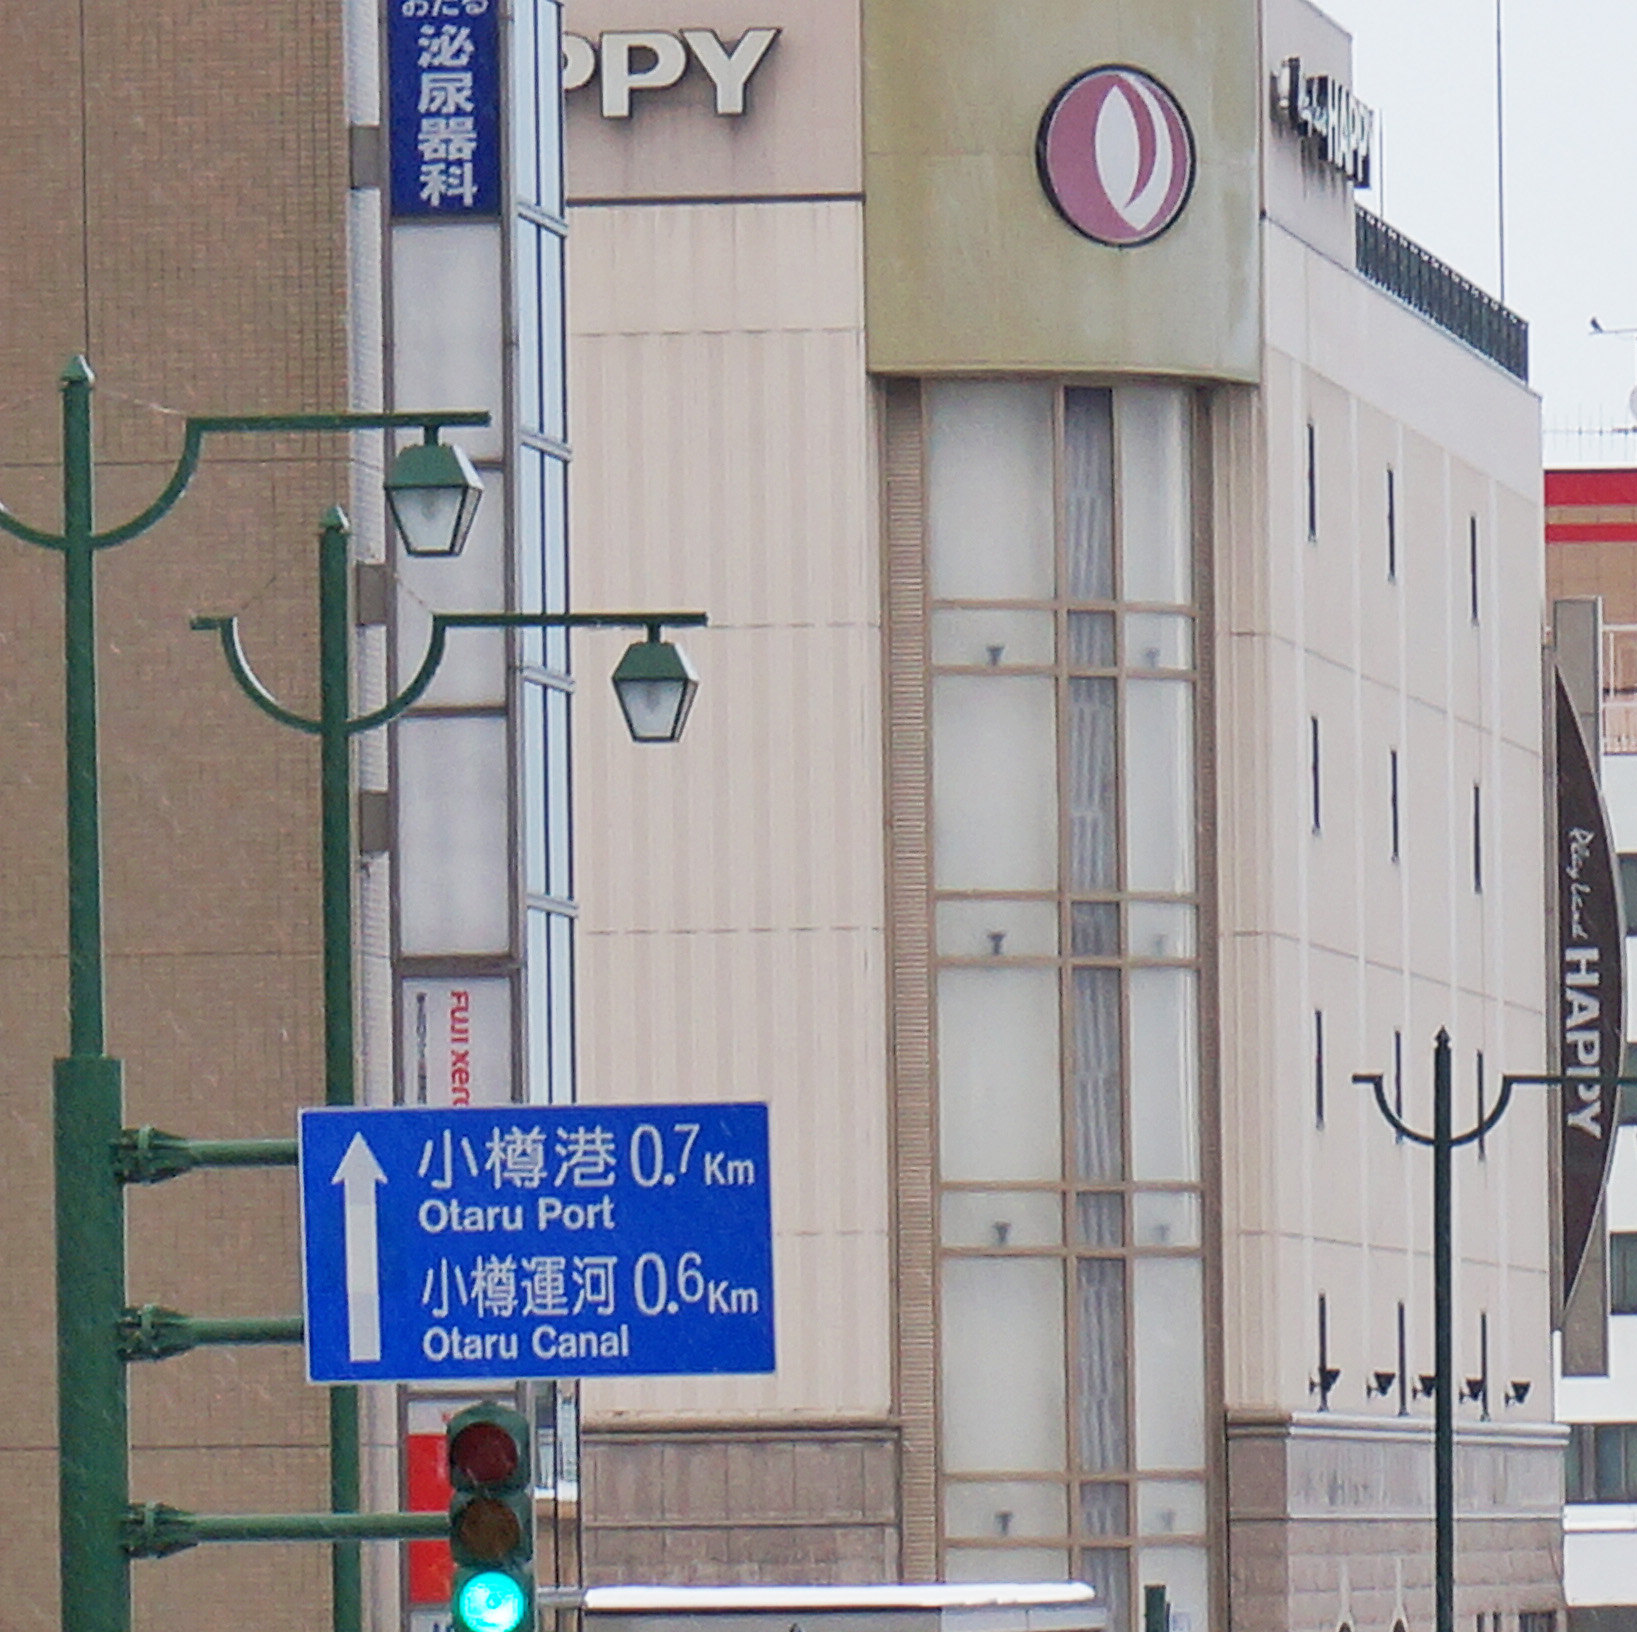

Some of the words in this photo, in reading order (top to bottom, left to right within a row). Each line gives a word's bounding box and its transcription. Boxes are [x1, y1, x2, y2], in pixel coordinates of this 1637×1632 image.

[417, 25, 477, 207] 泌尿器科
[451, 990, 470, 1043] FUJI
[1565, 947, 1601, 1139] HAPPY
[418, 1125, 617, 1190] 小樽港
[418, 1199, 523, 1233] Otaru
[538, 1195, 616, 1231] Port
[422, 1254, 618, 1319] 小樽運河
[422, 1326, 519, 1361] Otaru
[531, 1324, 630, 1358] Canal
